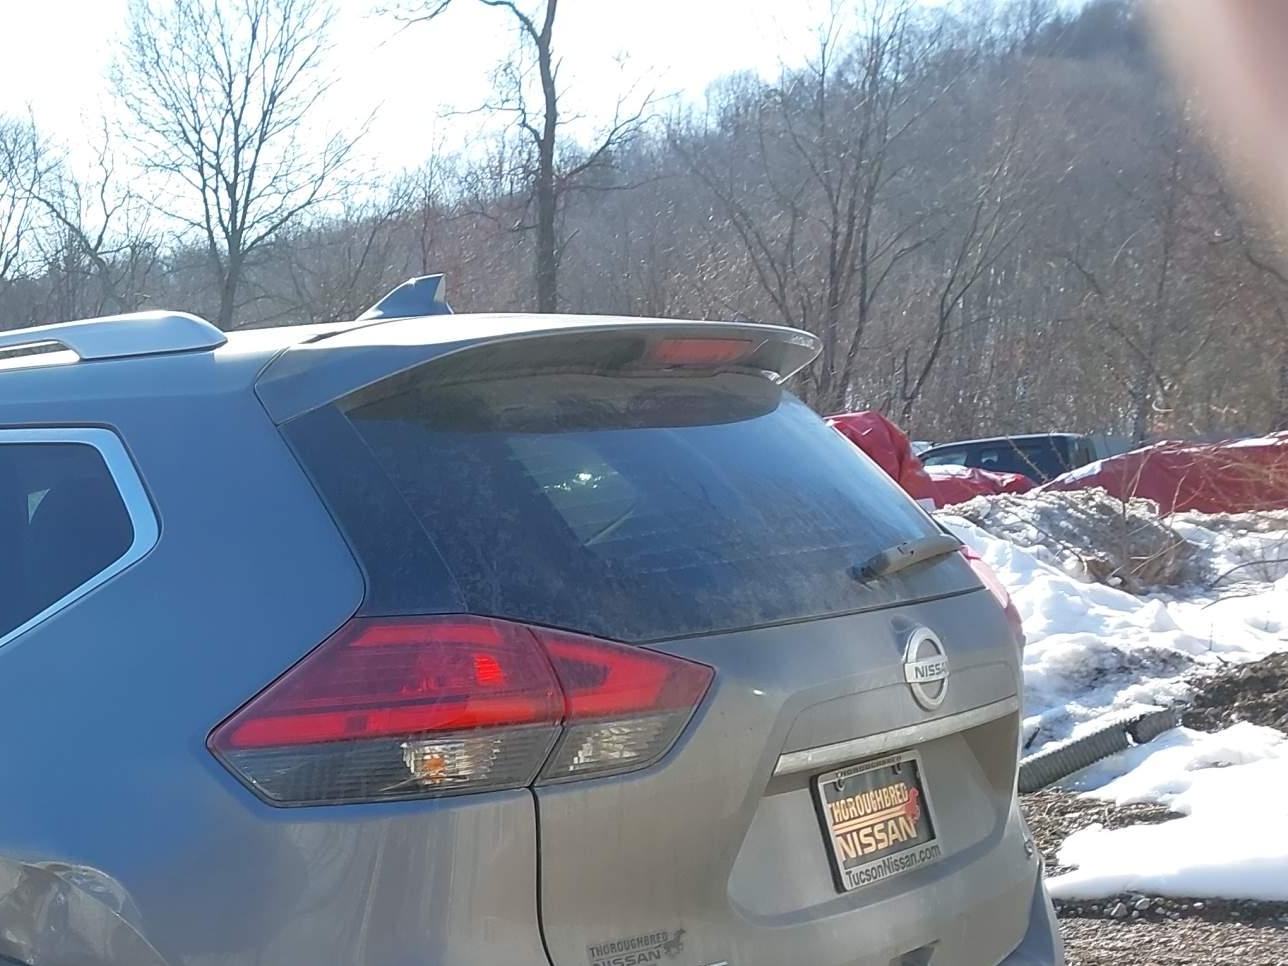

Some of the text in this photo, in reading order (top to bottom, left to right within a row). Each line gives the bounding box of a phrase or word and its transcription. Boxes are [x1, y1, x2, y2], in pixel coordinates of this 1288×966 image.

[836, 817, 917, 861] NISSAN
[846, 844, 941, 887] TucsonNissan.com
[589, 931, 669, 958] THOROUGHBRED
